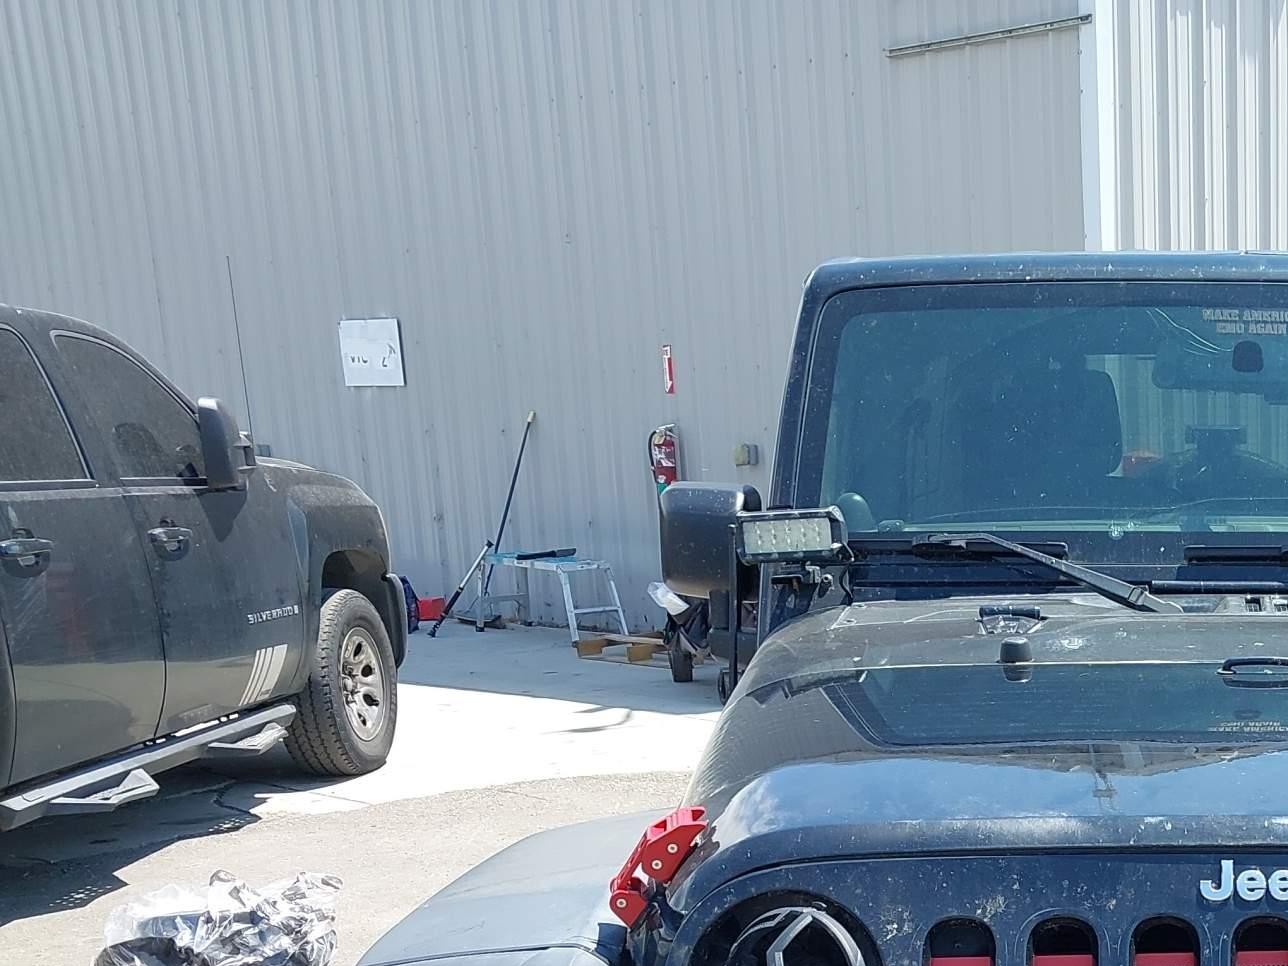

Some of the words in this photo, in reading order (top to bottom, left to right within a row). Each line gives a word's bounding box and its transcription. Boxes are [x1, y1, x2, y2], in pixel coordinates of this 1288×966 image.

[1202, 309, 1239, 321] MAKE
[1248, 322, 1287, 334] AGAIN
[247, 606, 293, 624] SILVERADO
